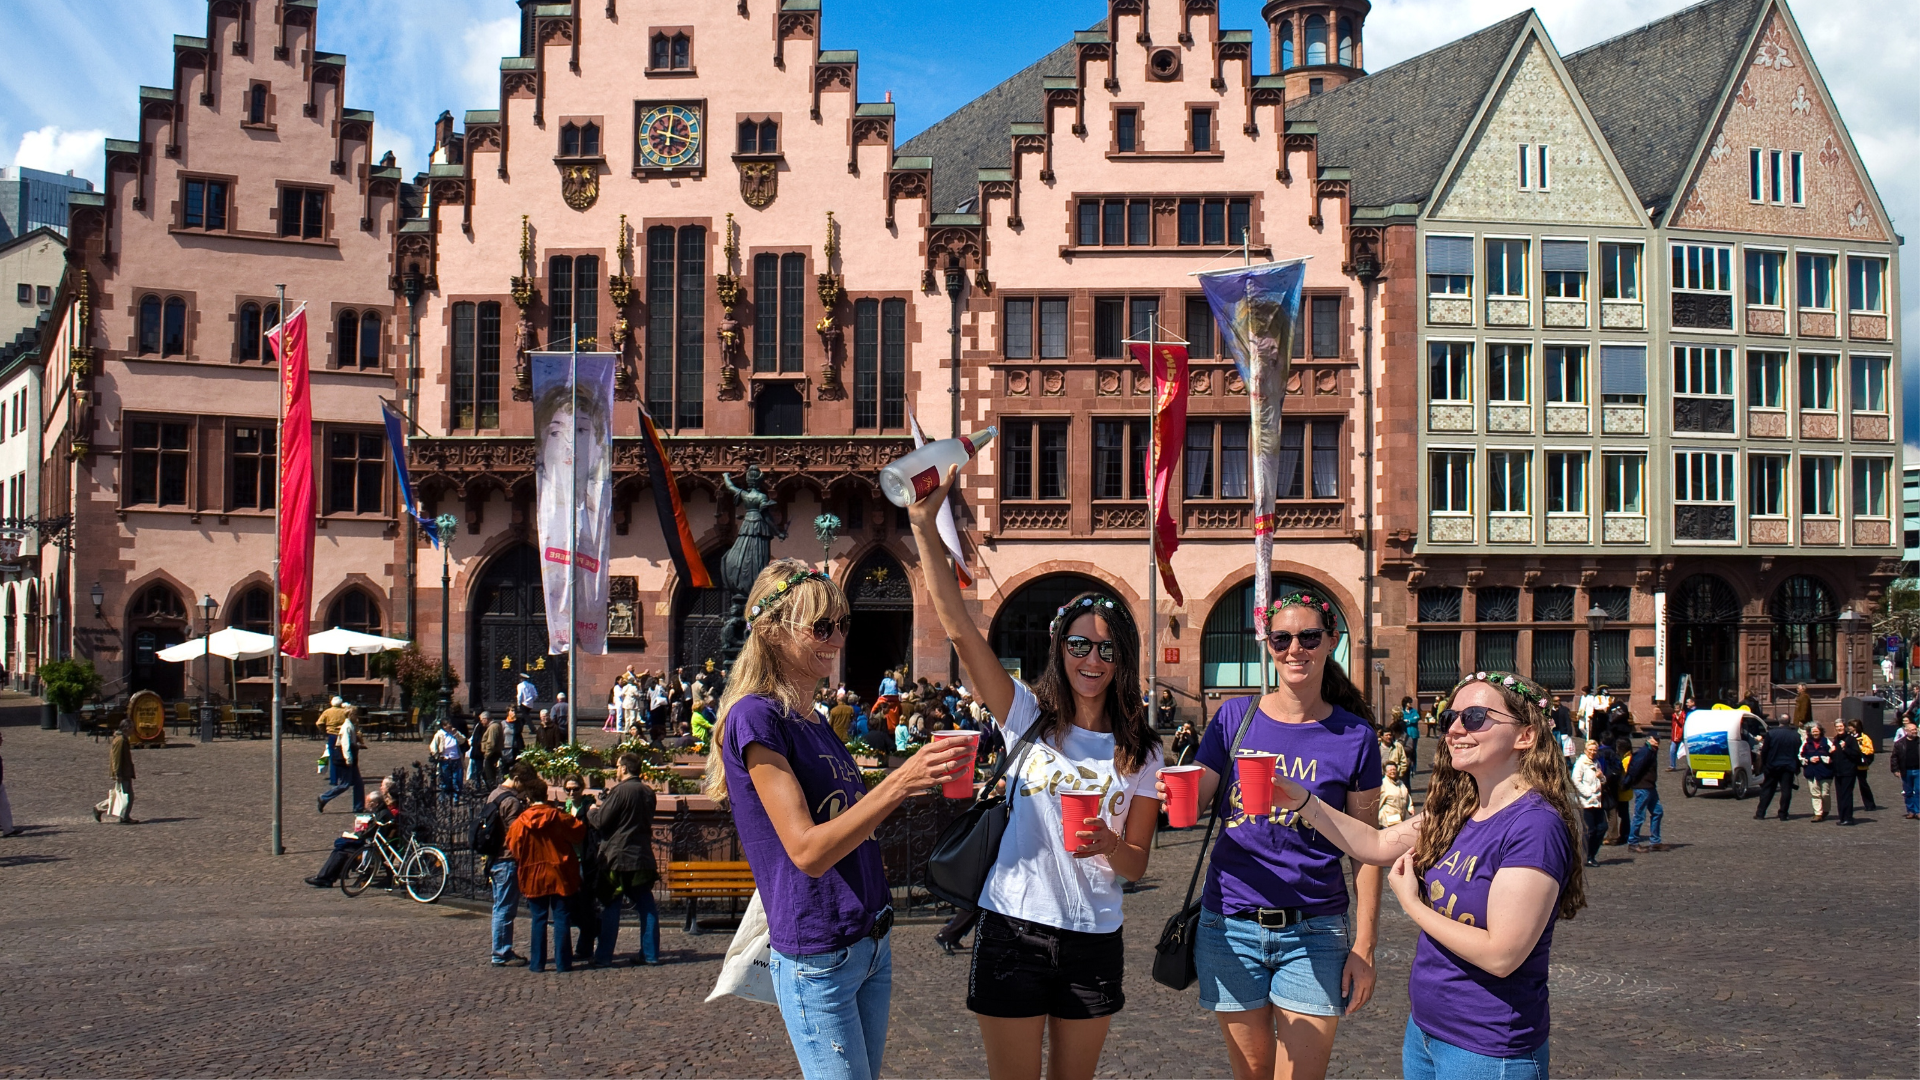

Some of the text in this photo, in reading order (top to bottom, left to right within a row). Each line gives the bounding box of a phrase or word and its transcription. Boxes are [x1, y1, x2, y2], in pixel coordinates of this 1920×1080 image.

[1658, 603, 1668, 666] Tourist Info
[818, 754, 863, 784] TEA
